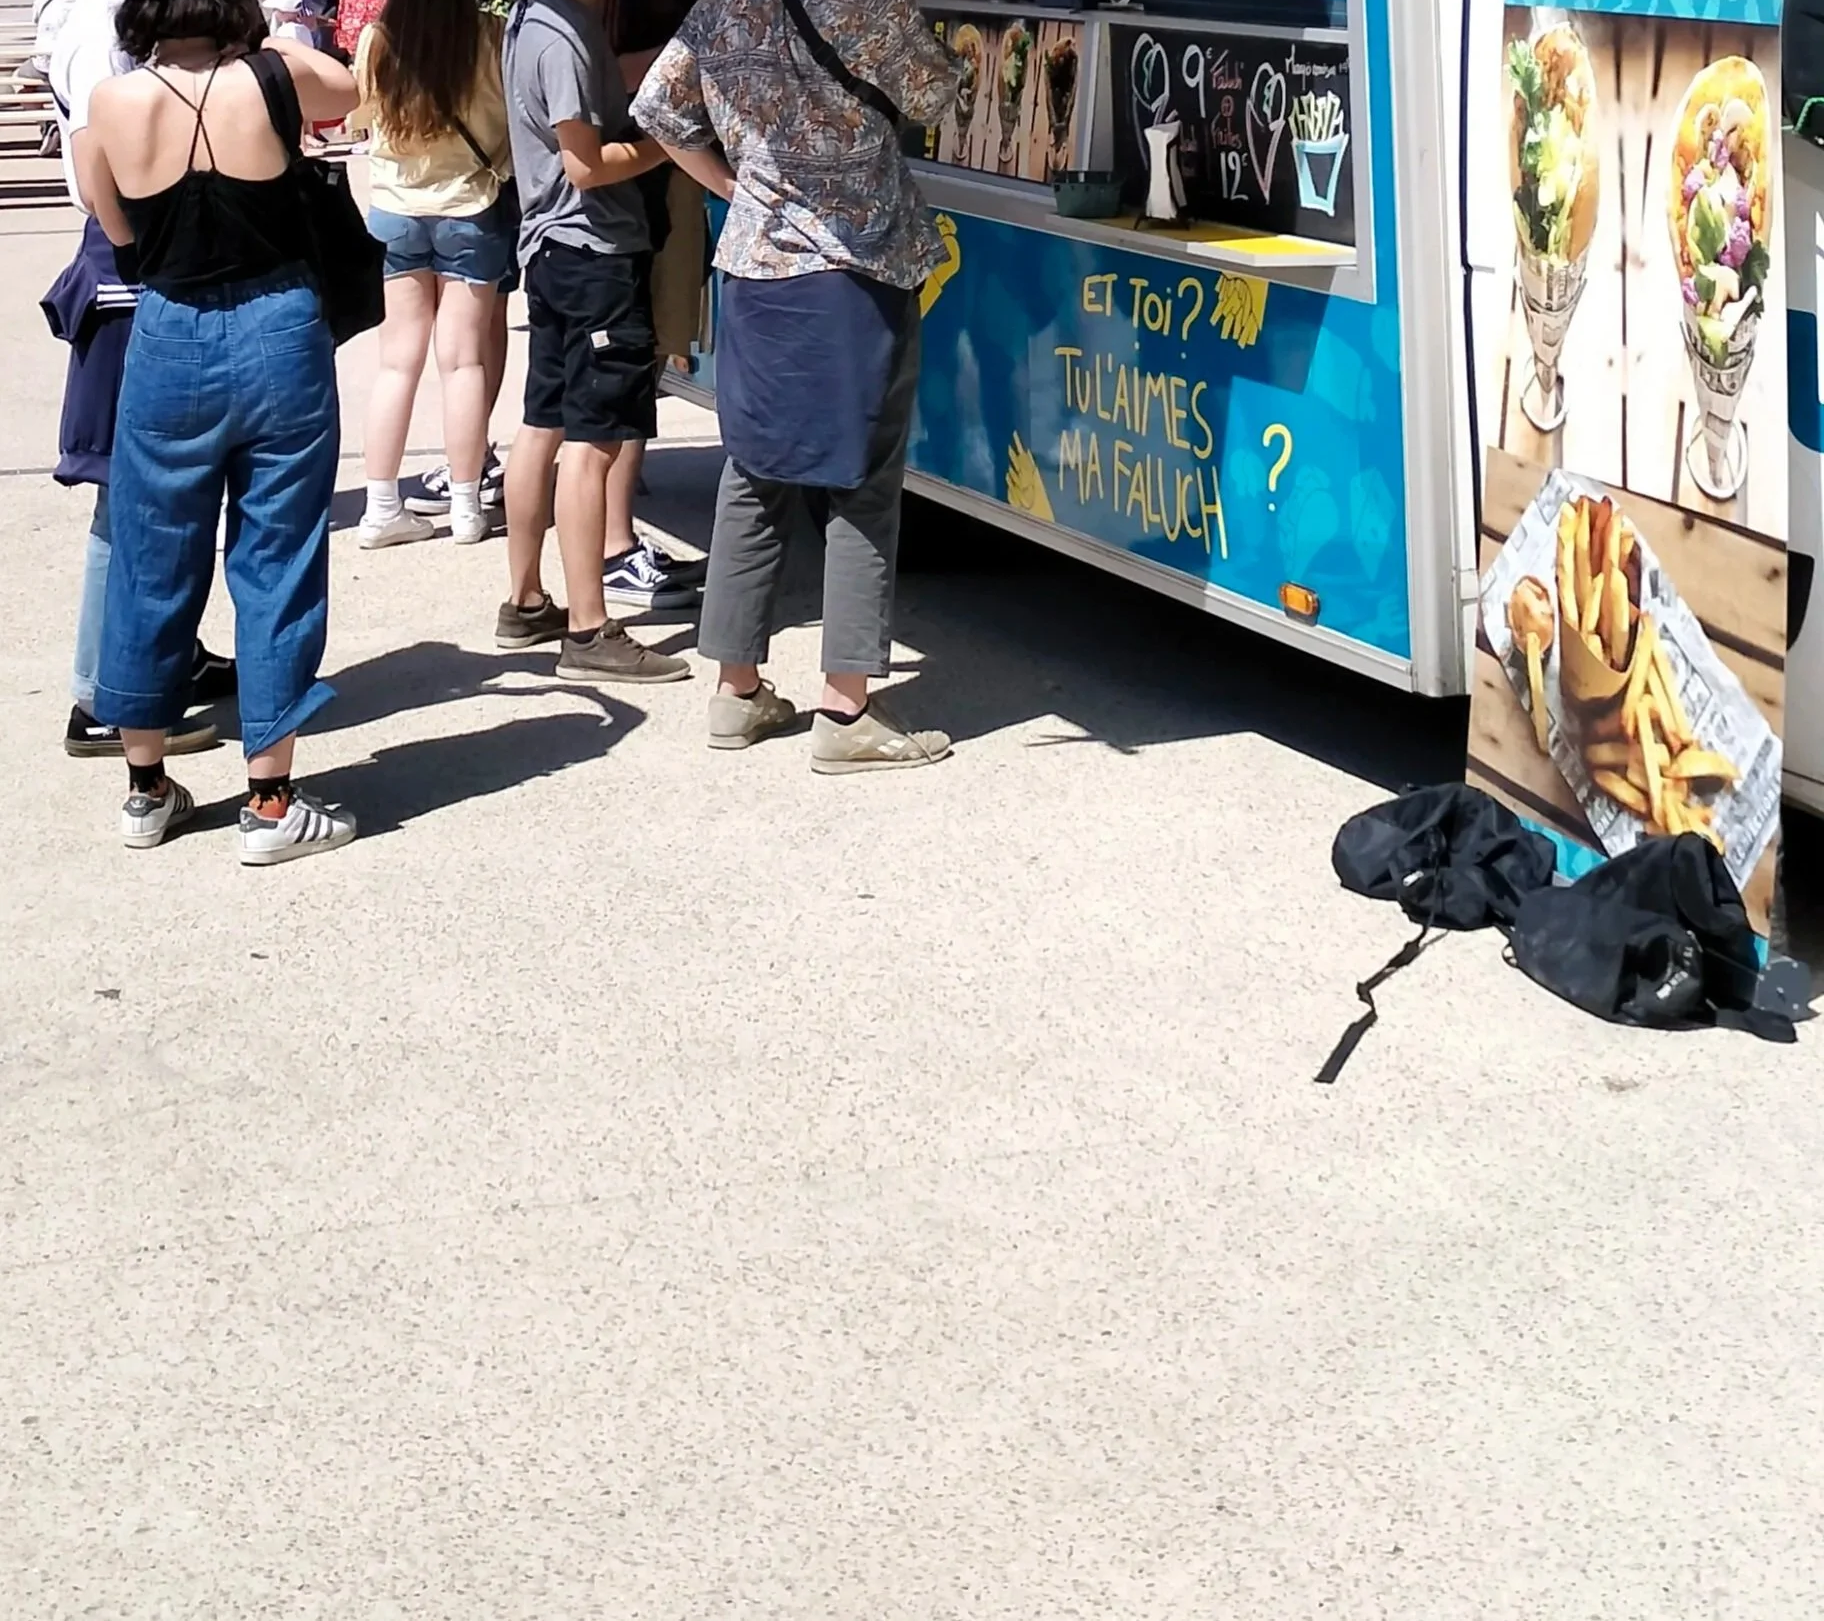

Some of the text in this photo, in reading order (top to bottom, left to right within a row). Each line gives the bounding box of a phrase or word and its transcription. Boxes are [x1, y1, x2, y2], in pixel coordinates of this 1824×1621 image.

[1083, 273, 1118, 317] ET
[1054, 346, 1215, 460] TU L'AIMES
[1058, 422, 1293, 561] MA FALUCH ?
